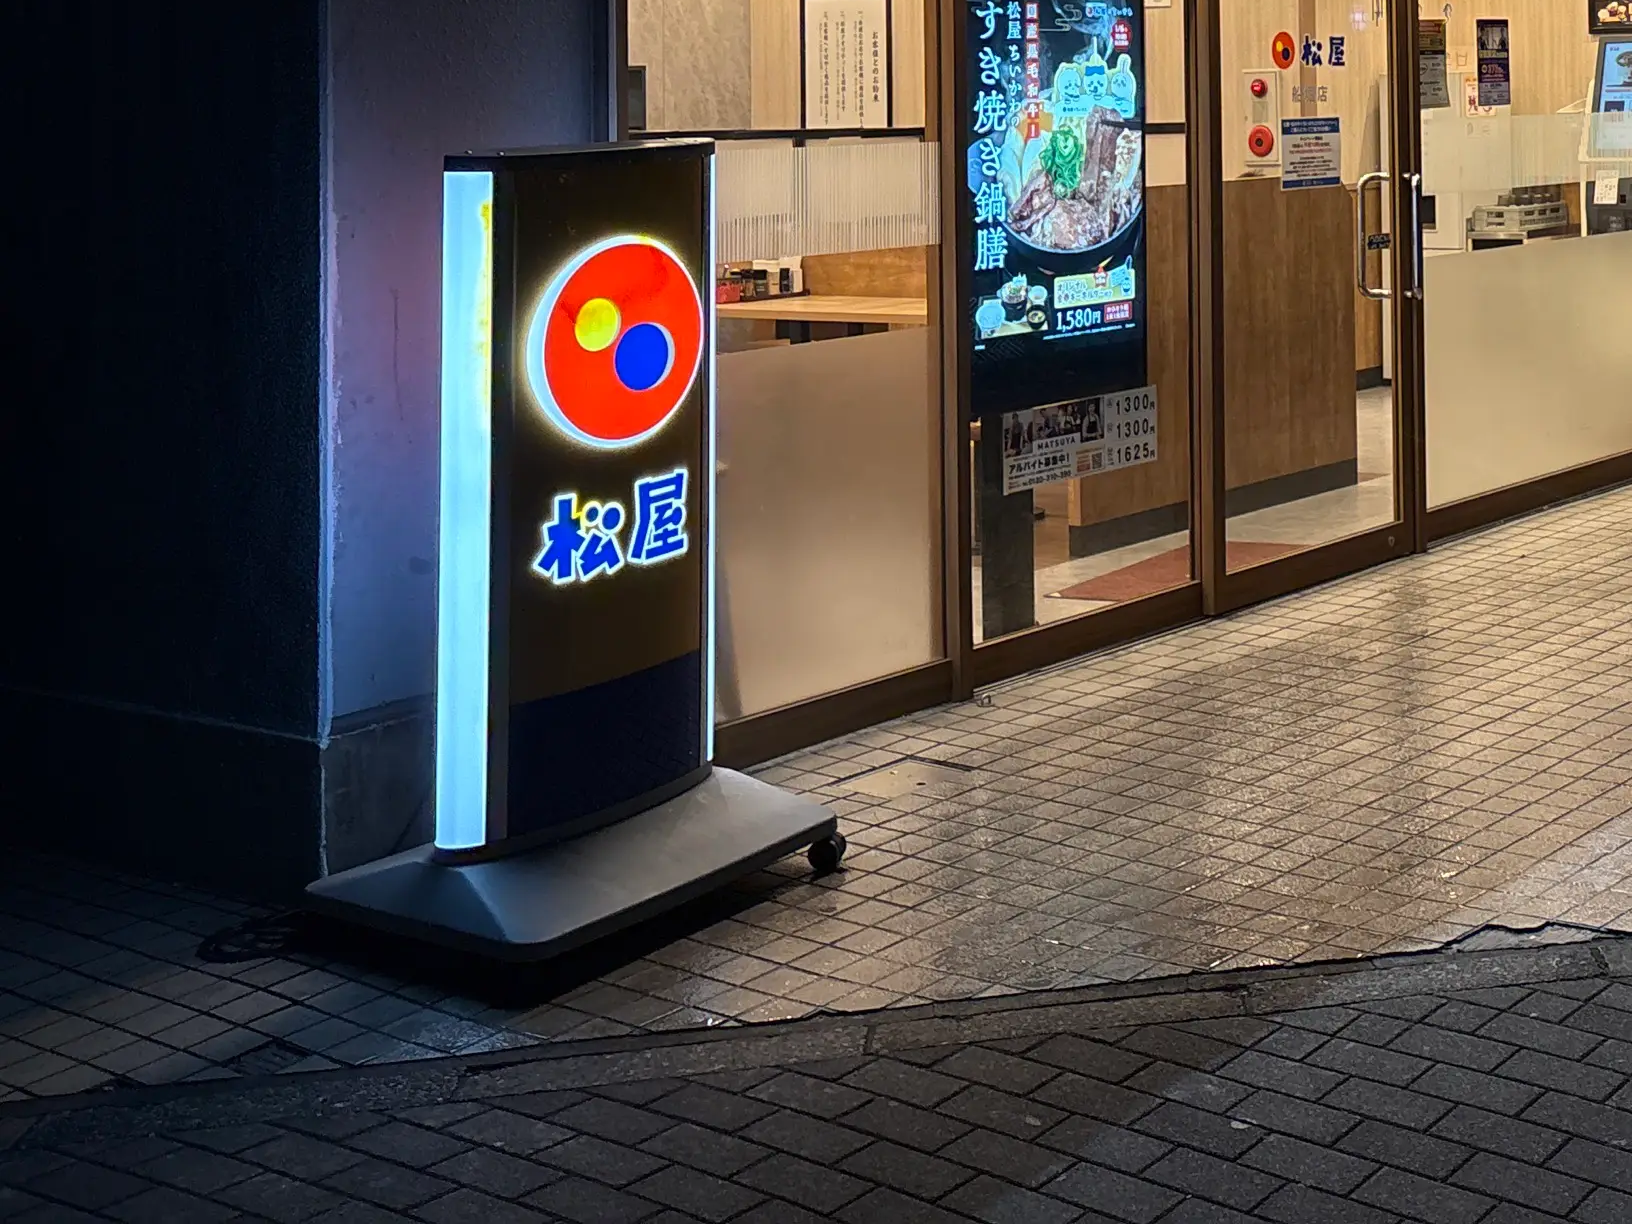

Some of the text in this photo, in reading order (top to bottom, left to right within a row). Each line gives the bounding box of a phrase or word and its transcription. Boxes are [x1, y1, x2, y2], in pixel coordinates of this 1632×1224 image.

[1301, 35, 1345, 67] 松屋
[973, 0, 1008, 271] すき焼き鍋膳
[1056, 308, 1101, 332] 1,580円
[1037, 437, 1076, 451] MATSUYA
[533, 469, 688, 585] 松屋
